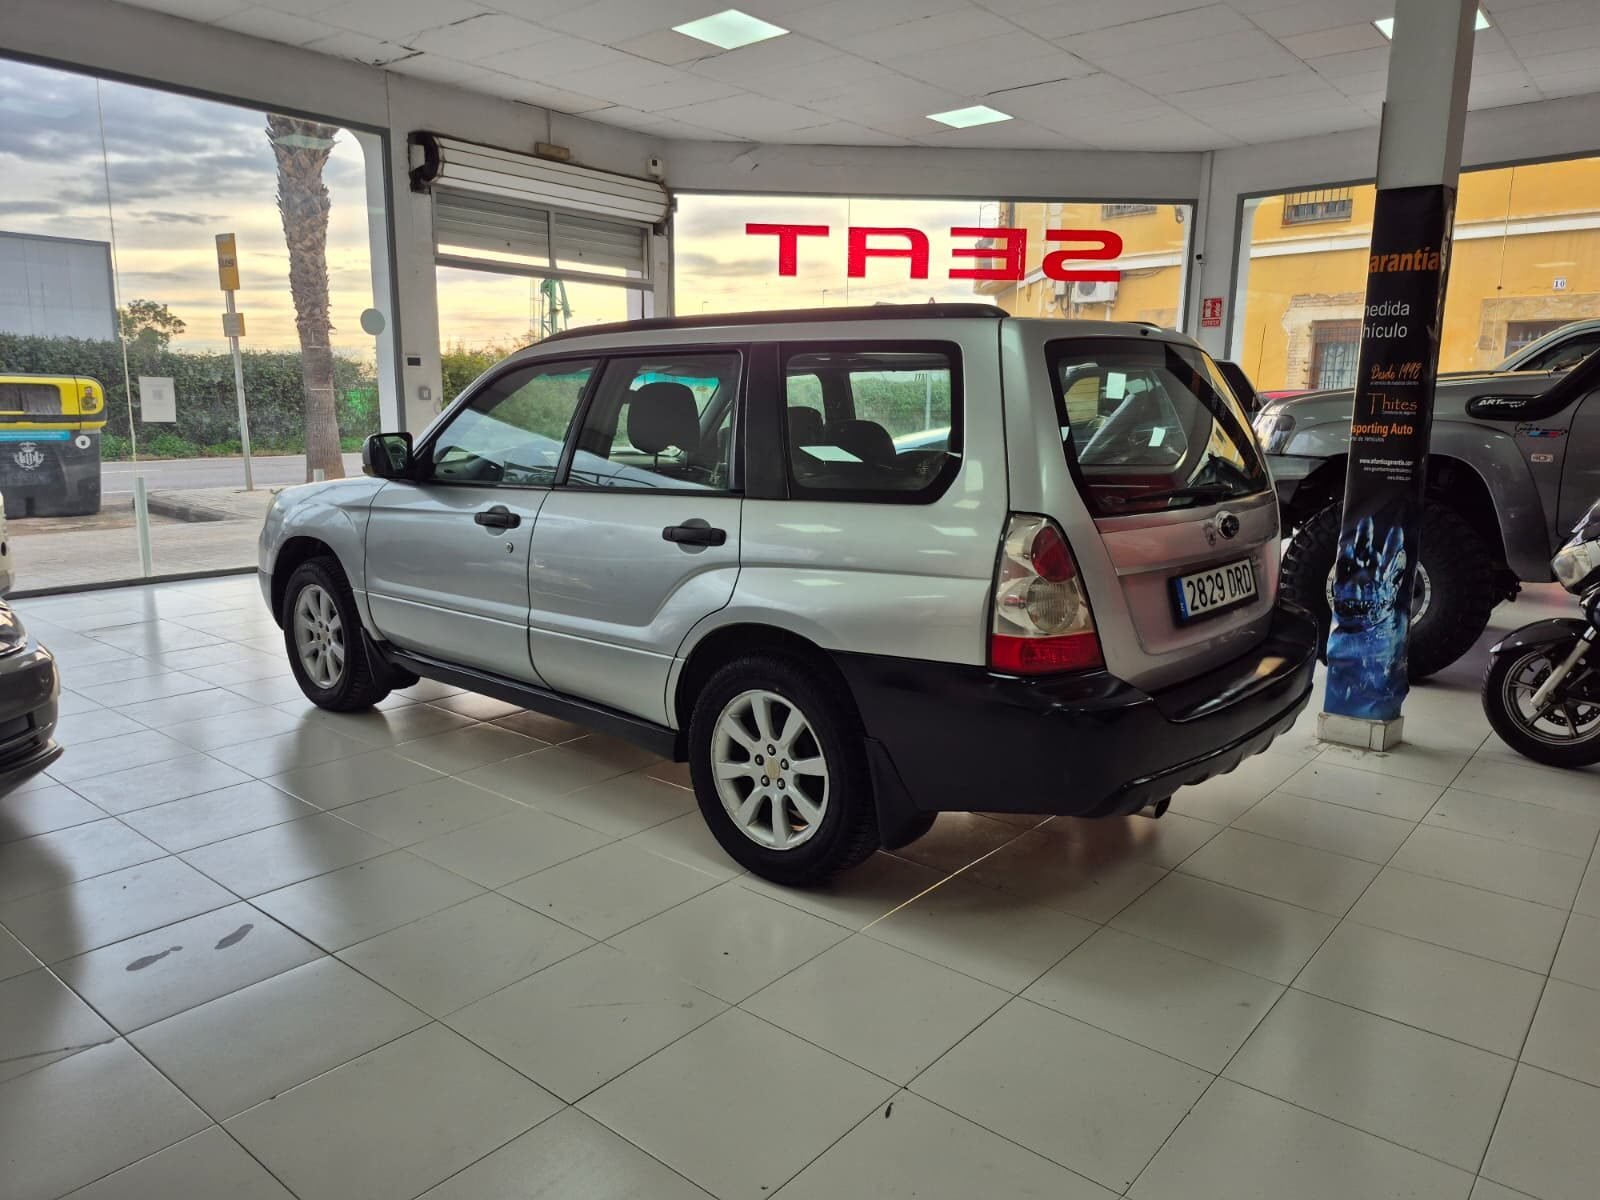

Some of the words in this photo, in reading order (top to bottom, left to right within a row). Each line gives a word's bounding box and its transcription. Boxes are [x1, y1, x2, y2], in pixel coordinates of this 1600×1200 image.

[1370, 363, 1396, 380] Desde
[1398, 361, 1424, 380] 1998
[1368, 392, 1418, 415] Thites
[1390, 422, 1414, 435] Auto
[1186, 572, 1226, 611] 2829
[1226, 564, 1252, 598] DRD
